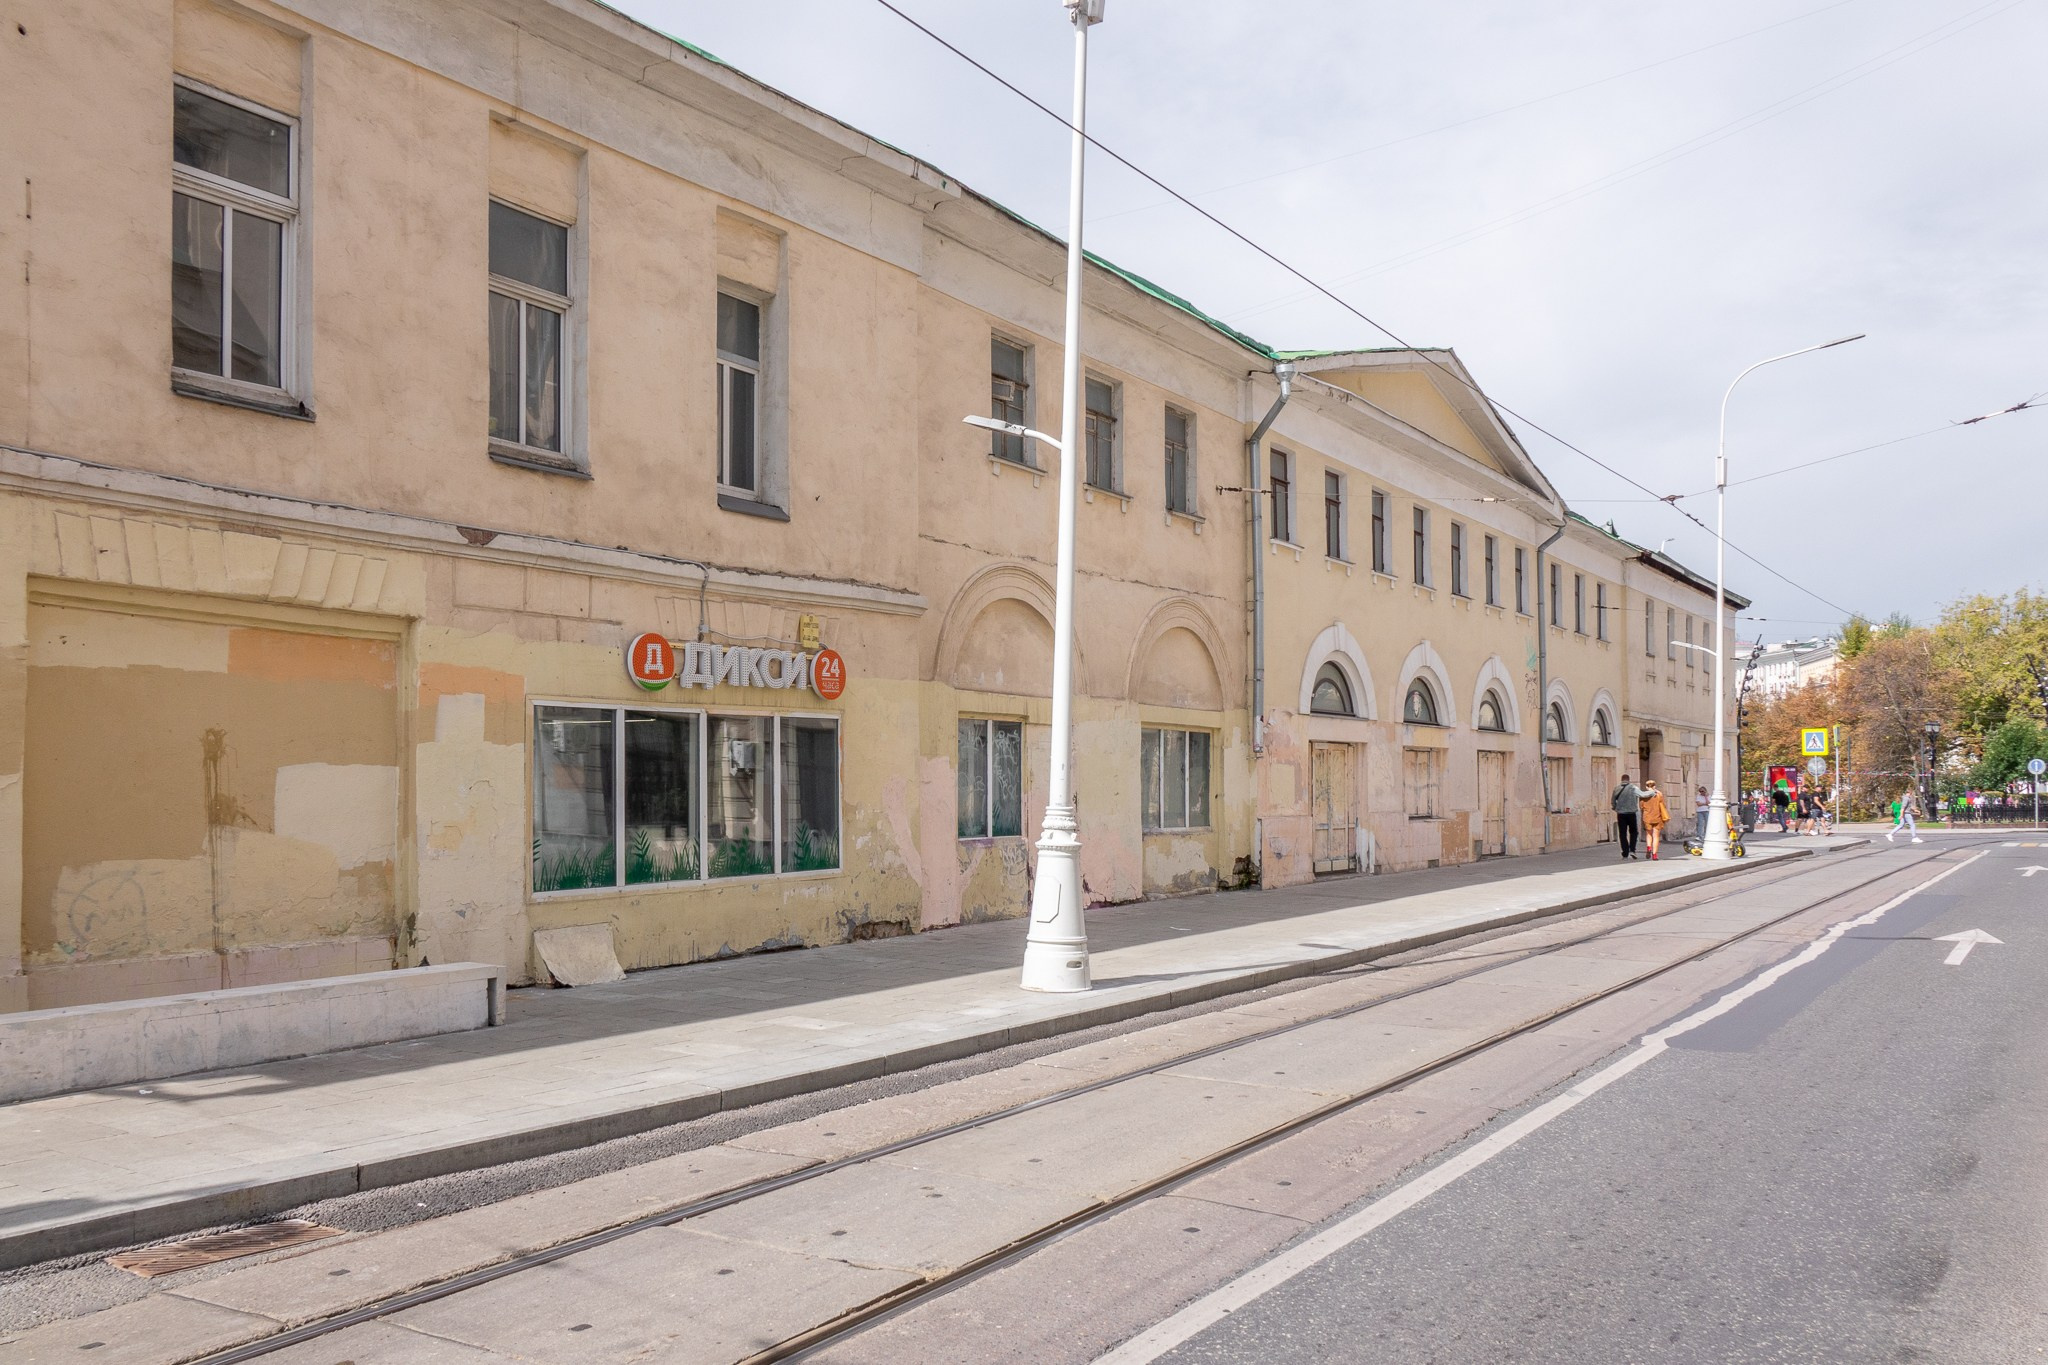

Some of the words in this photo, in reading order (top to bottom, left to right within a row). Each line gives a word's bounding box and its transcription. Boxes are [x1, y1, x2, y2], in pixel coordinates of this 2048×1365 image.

[644, 643, 665, 675] Д
[680, 642, 807, 690] ДИКСИ
[821, 657, 840, 678] 24
